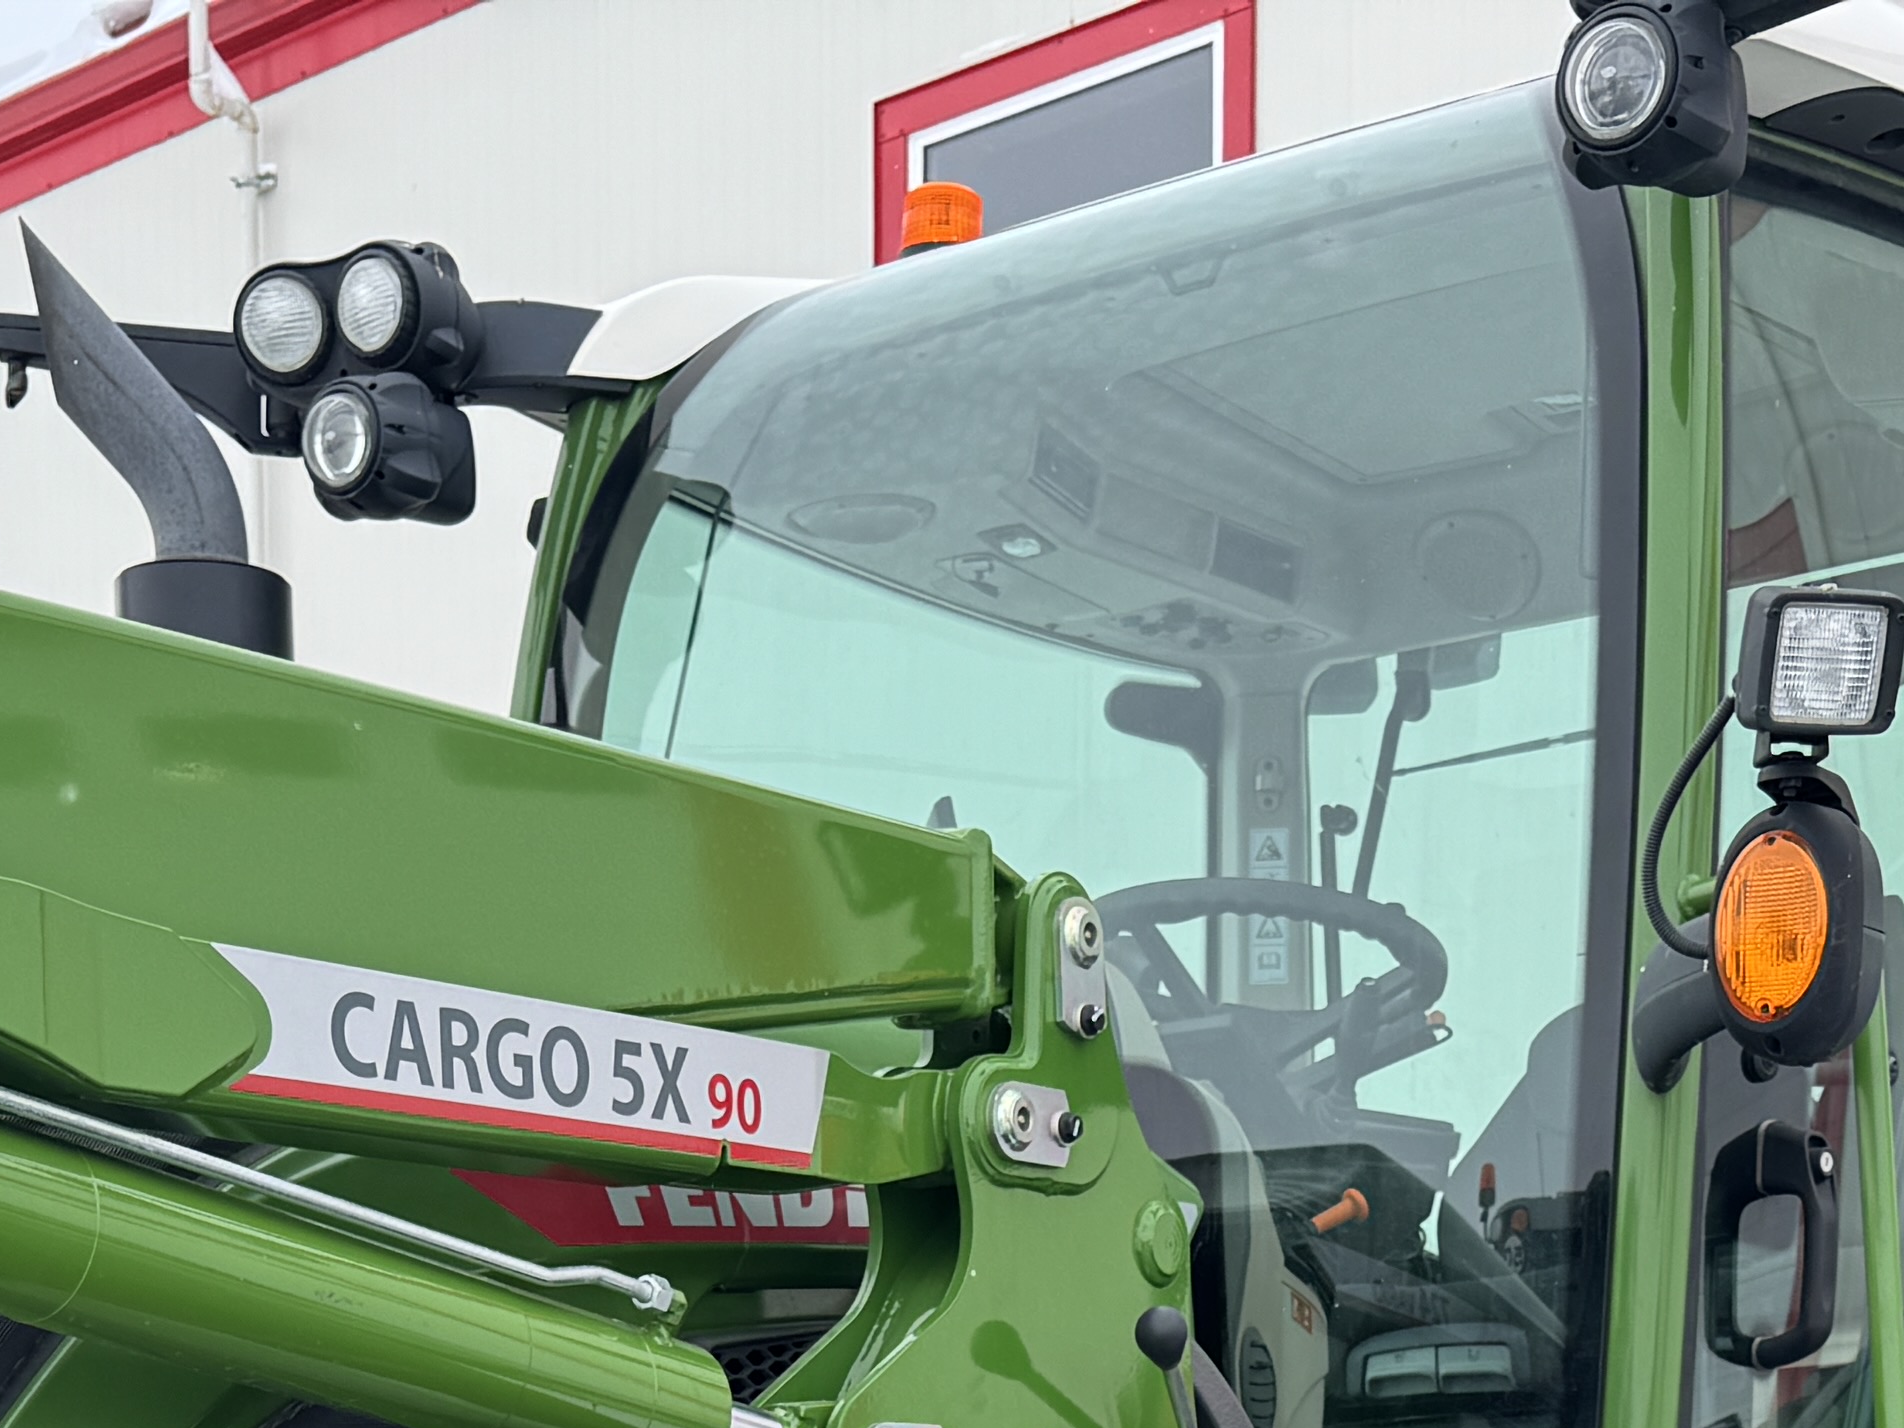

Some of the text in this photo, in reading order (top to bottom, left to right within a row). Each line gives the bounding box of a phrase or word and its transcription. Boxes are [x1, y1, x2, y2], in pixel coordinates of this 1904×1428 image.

[331, 991, 762, 1135] CARGO 5X 90
